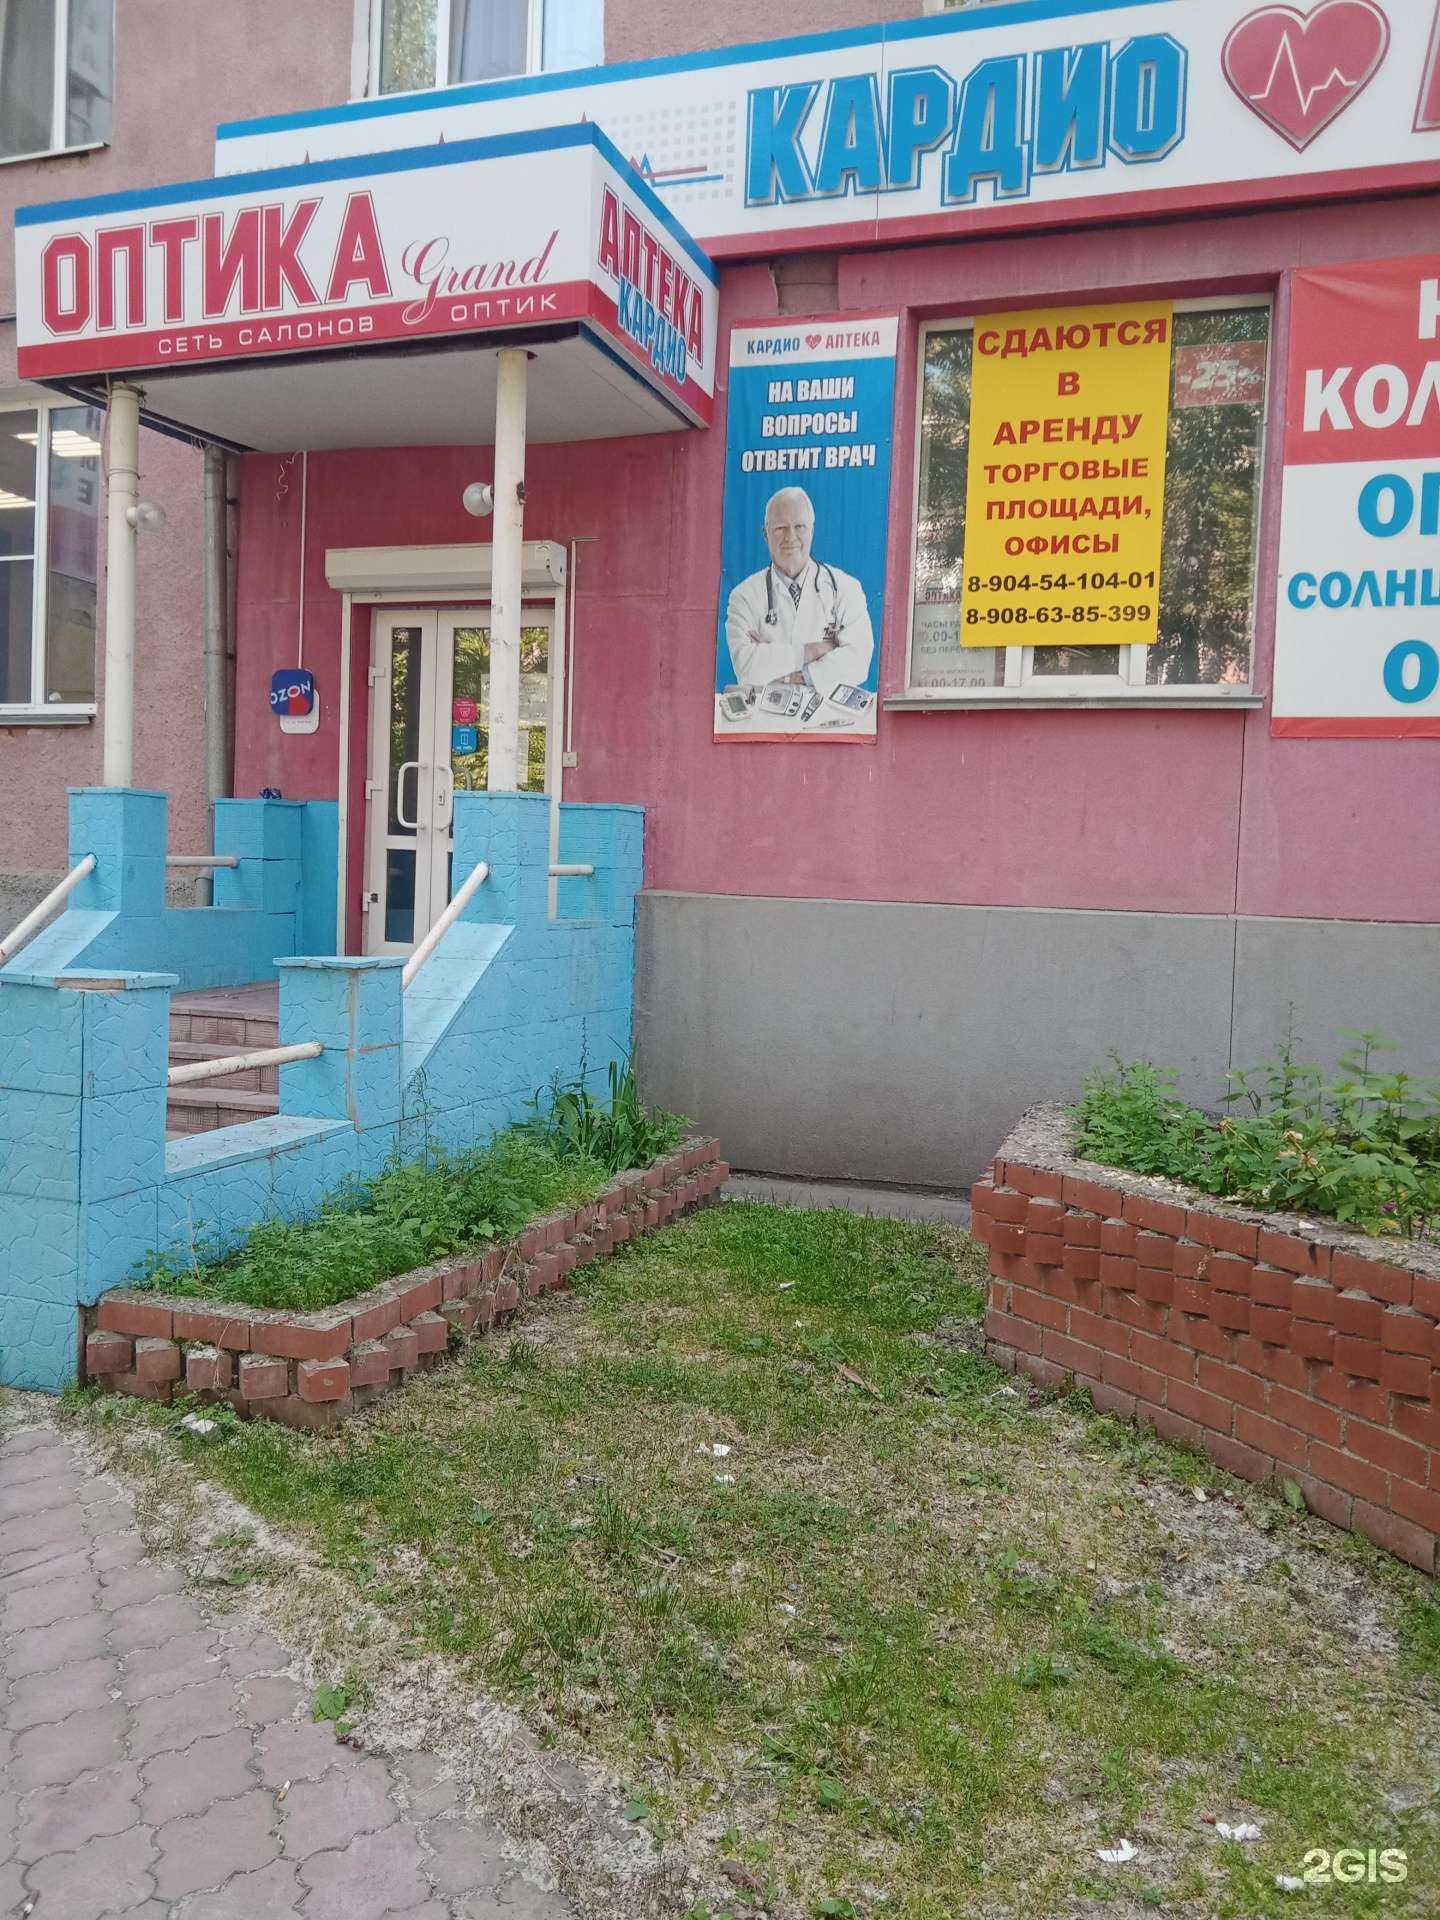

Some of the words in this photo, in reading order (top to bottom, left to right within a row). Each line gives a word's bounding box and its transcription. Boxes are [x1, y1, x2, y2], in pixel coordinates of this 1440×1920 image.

[744, 33, 1188, 208] КАРДИО
[41, 190, 393, 337] ОПТИКА
[402, 229, 559, 325] Grand
[598, 182, 703, 369] АПТЕКА
[451, 293, 558, 322] ОПТИК
[158, 334, 223, 355] СЕТЬ
[239, 316, 374, 346] САЛОНОВ
[617, 274, 687, 385] КАРДИО
[747, 337, 801, 355] КАРДИО
[825, 331, 880, 349] АПТЕКА
[977, 318, 1168, 360] СДАЮТСЯ
[768, 380, 793, 403] НА
[797, 376, 854, 401] ВАШИ
[1057, 371, 1081, 397] В
[762, 411, 858, 438] ВОПРОСЫ
[993, 413, 1143, 446] АРЕНДУ
[741, 446, 822, 472] ОТВЕТИТ
[825, 444, 876, 469] ВРАЧ
[983, 457, 1150, 485] ТОРГОВЫЕ
[985, 494, 1152, 521] ПЛОЩАДИ,
[1004, 533, 1120, 557] ОФИСЫ
[967, 570, 1156, 594] 8-904-54-104-01
[965, 604, 1152, 625] 8-908-63-85-399
[270, 680, 311, 705] OZON
